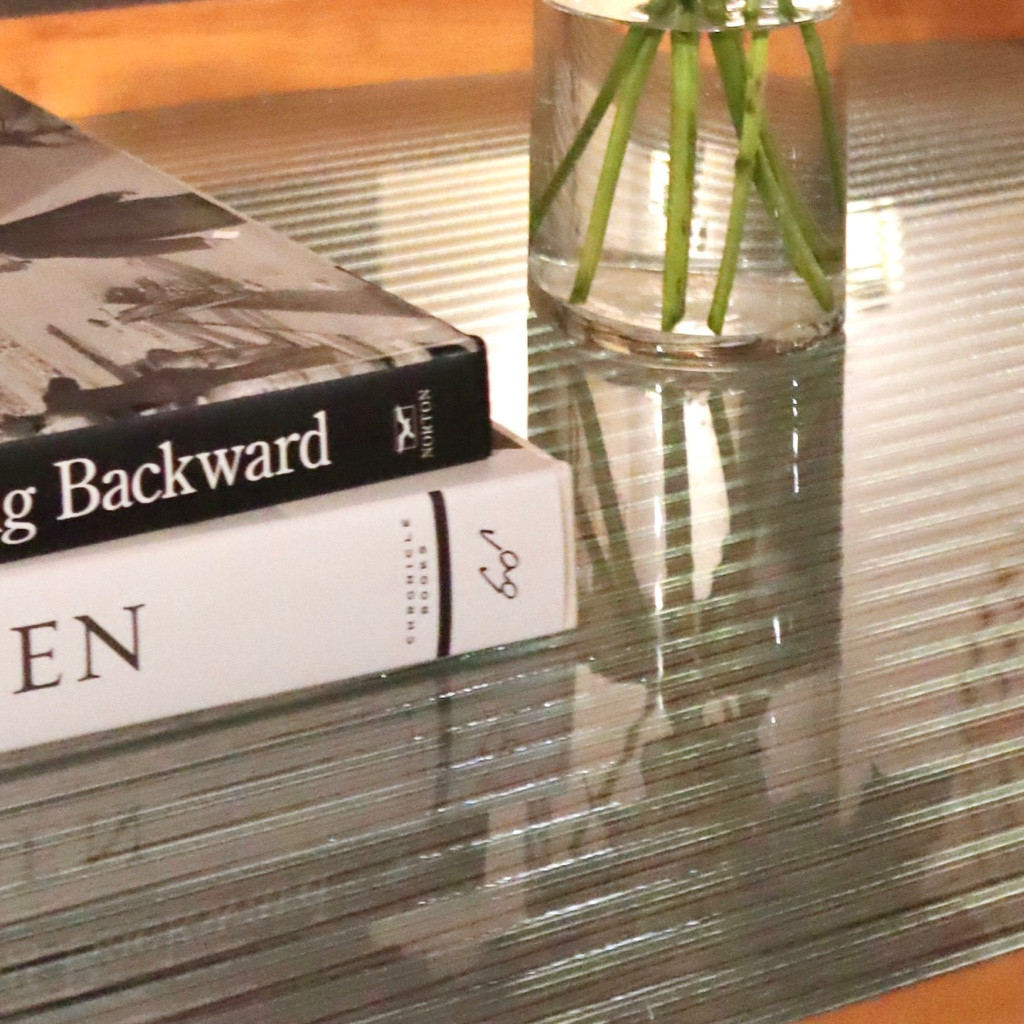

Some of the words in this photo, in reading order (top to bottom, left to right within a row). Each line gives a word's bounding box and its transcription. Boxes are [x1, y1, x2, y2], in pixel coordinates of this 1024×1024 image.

[53, 411, 333, 521] Backward
[417, 389, 435, 459] NORTON
[401, 519, 416, 645] CHRONICLE
